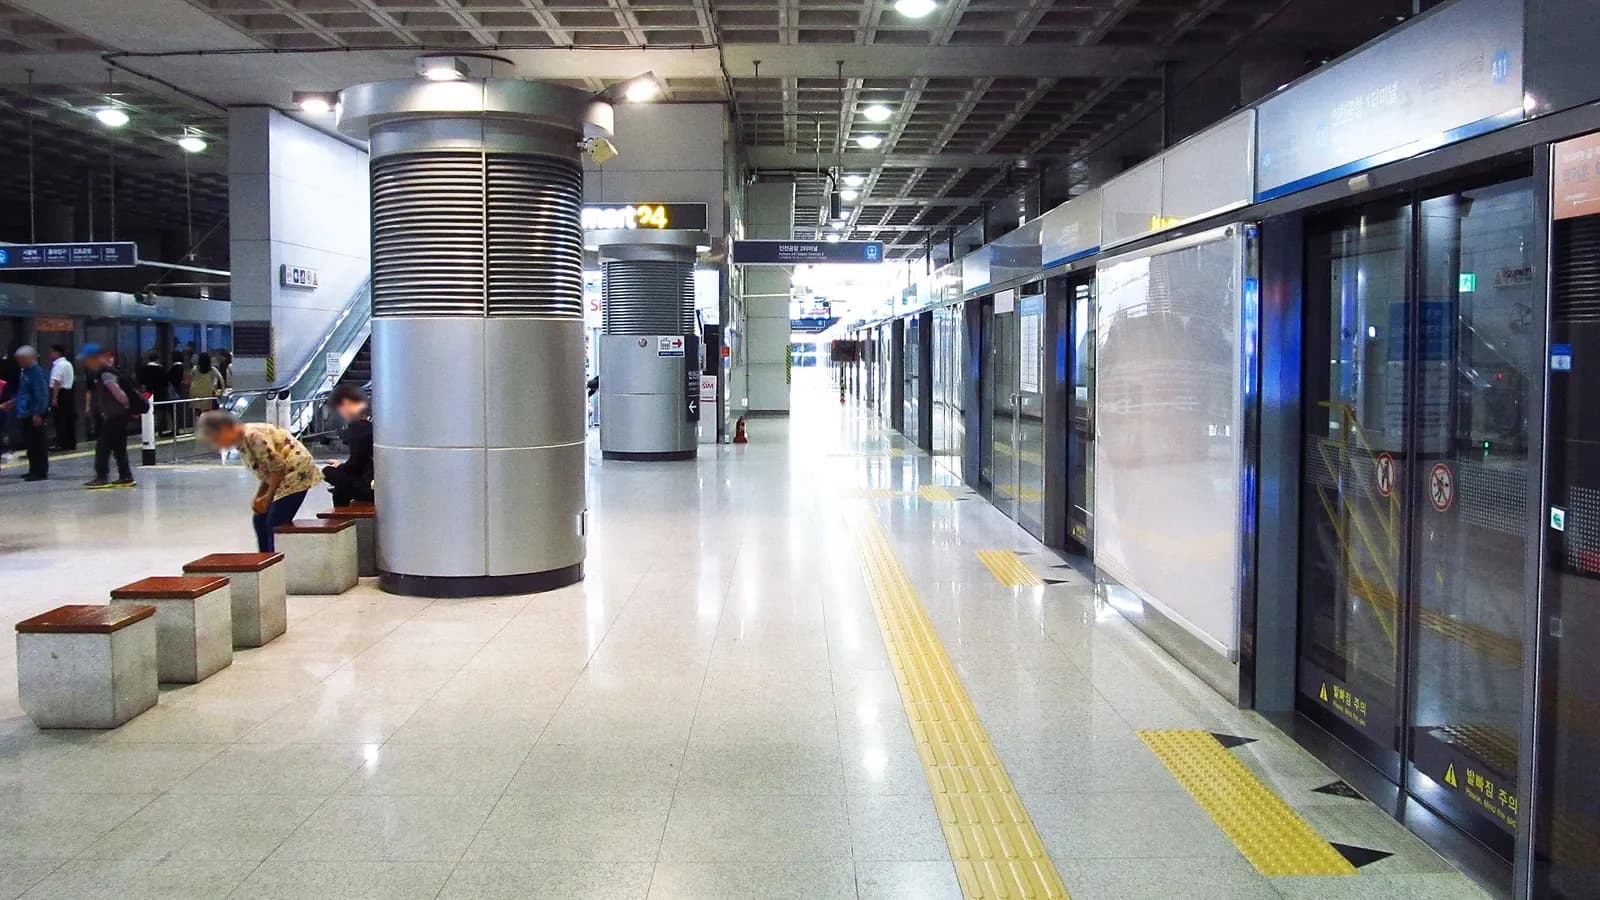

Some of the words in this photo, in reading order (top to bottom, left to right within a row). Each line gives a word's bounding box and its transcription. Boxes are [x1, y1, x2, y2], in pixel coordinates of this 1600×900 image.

[1491, 56, 1507, 80] A11
[1333, 684, 1351, 706] 발빠짐
[1353, 697, 1367, 717] 주의
[1466, 768, 1494, 799] 발빠짐
[1498, 788, 1518, 816] 주의
